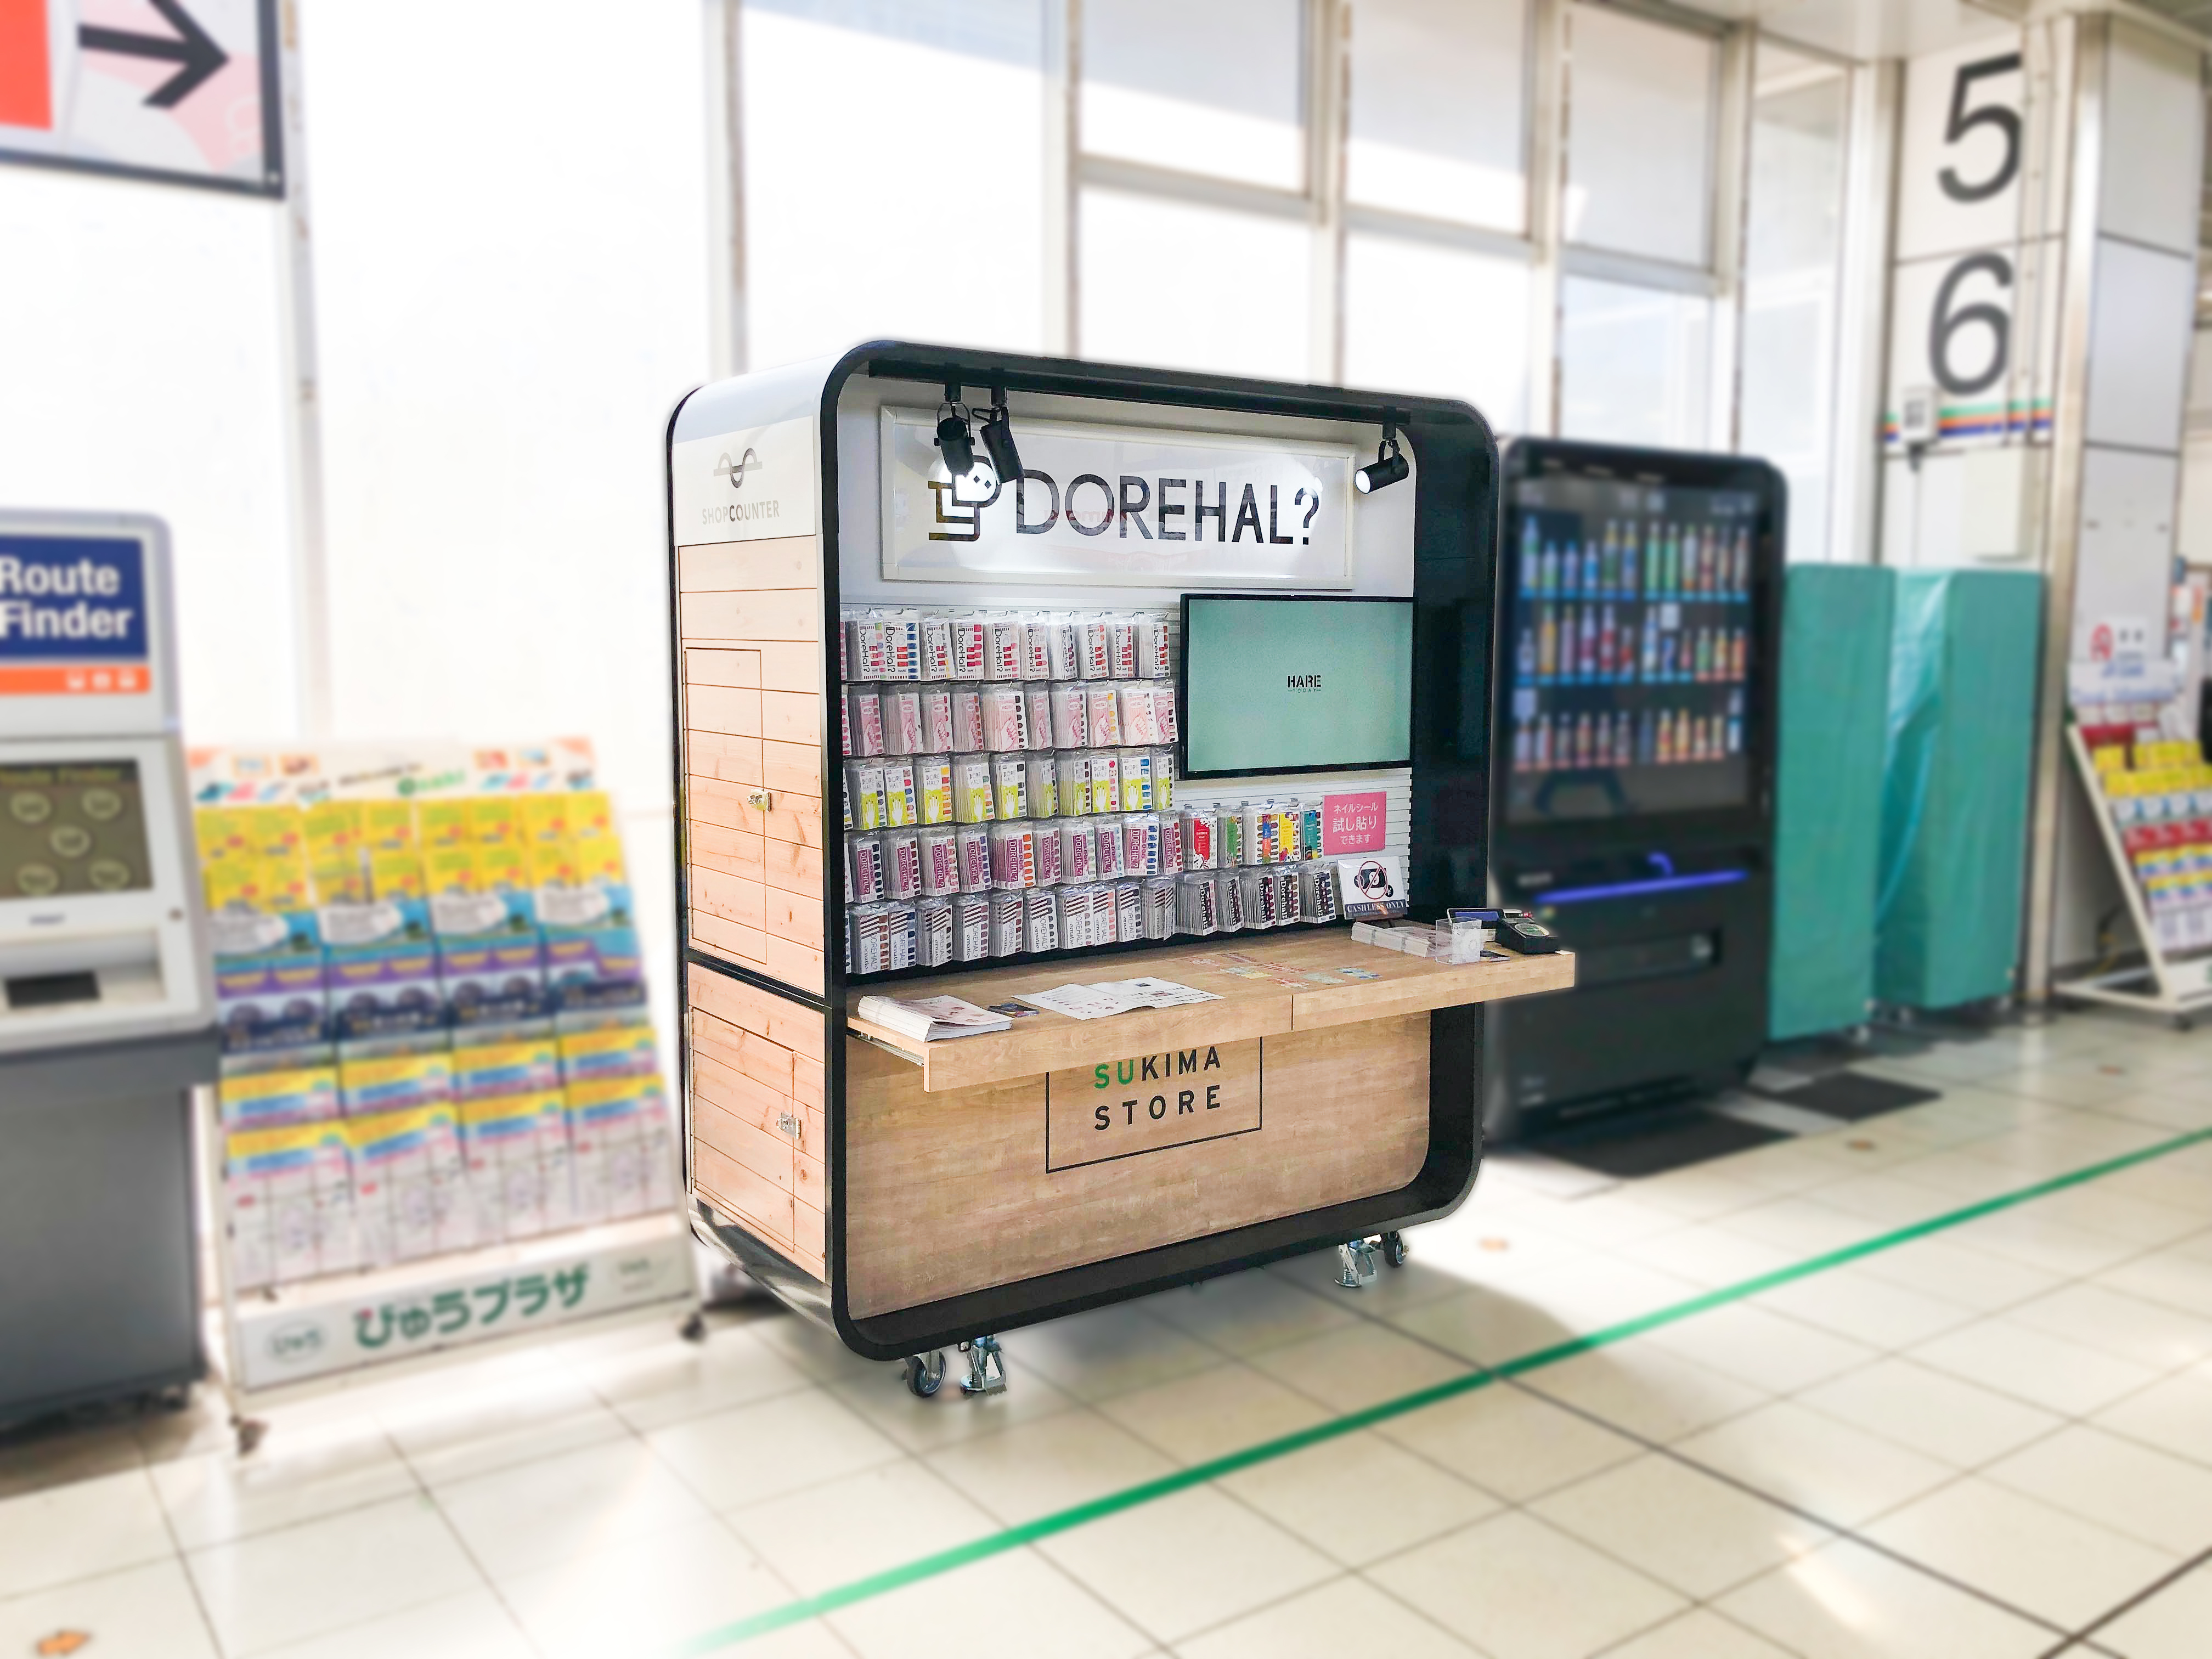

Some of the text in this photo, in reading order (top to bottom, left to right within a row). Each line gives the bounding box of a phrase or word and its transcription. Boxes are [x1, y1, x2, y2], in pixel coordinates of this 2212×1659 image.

[1937, 52, 2022, 204] 5
[1928, 250, 2014, 396] 6
[702, 500, 779, 525] SHOPCOUNTER
[1015, 470, 1321, 546] DOREHAL?
[0, 555, 120, 597] Route
[0, 601, 134, 640] Finder
[1288, 675, 1321, 687] HARE
[1333, 816, 1377, 833] 試し貼り
[1334, 803, 1378, 813] ネイルシール
[1340, 834, 1371, 845] できます
[1347, 903, 1385, 913] CASHLESS
[1094, 1046, 1221, 1090] SUKIMA
[1094, 1085, 1221, 1131] STORE
[353, 1264, 590, 1348] びゅうプラザ
